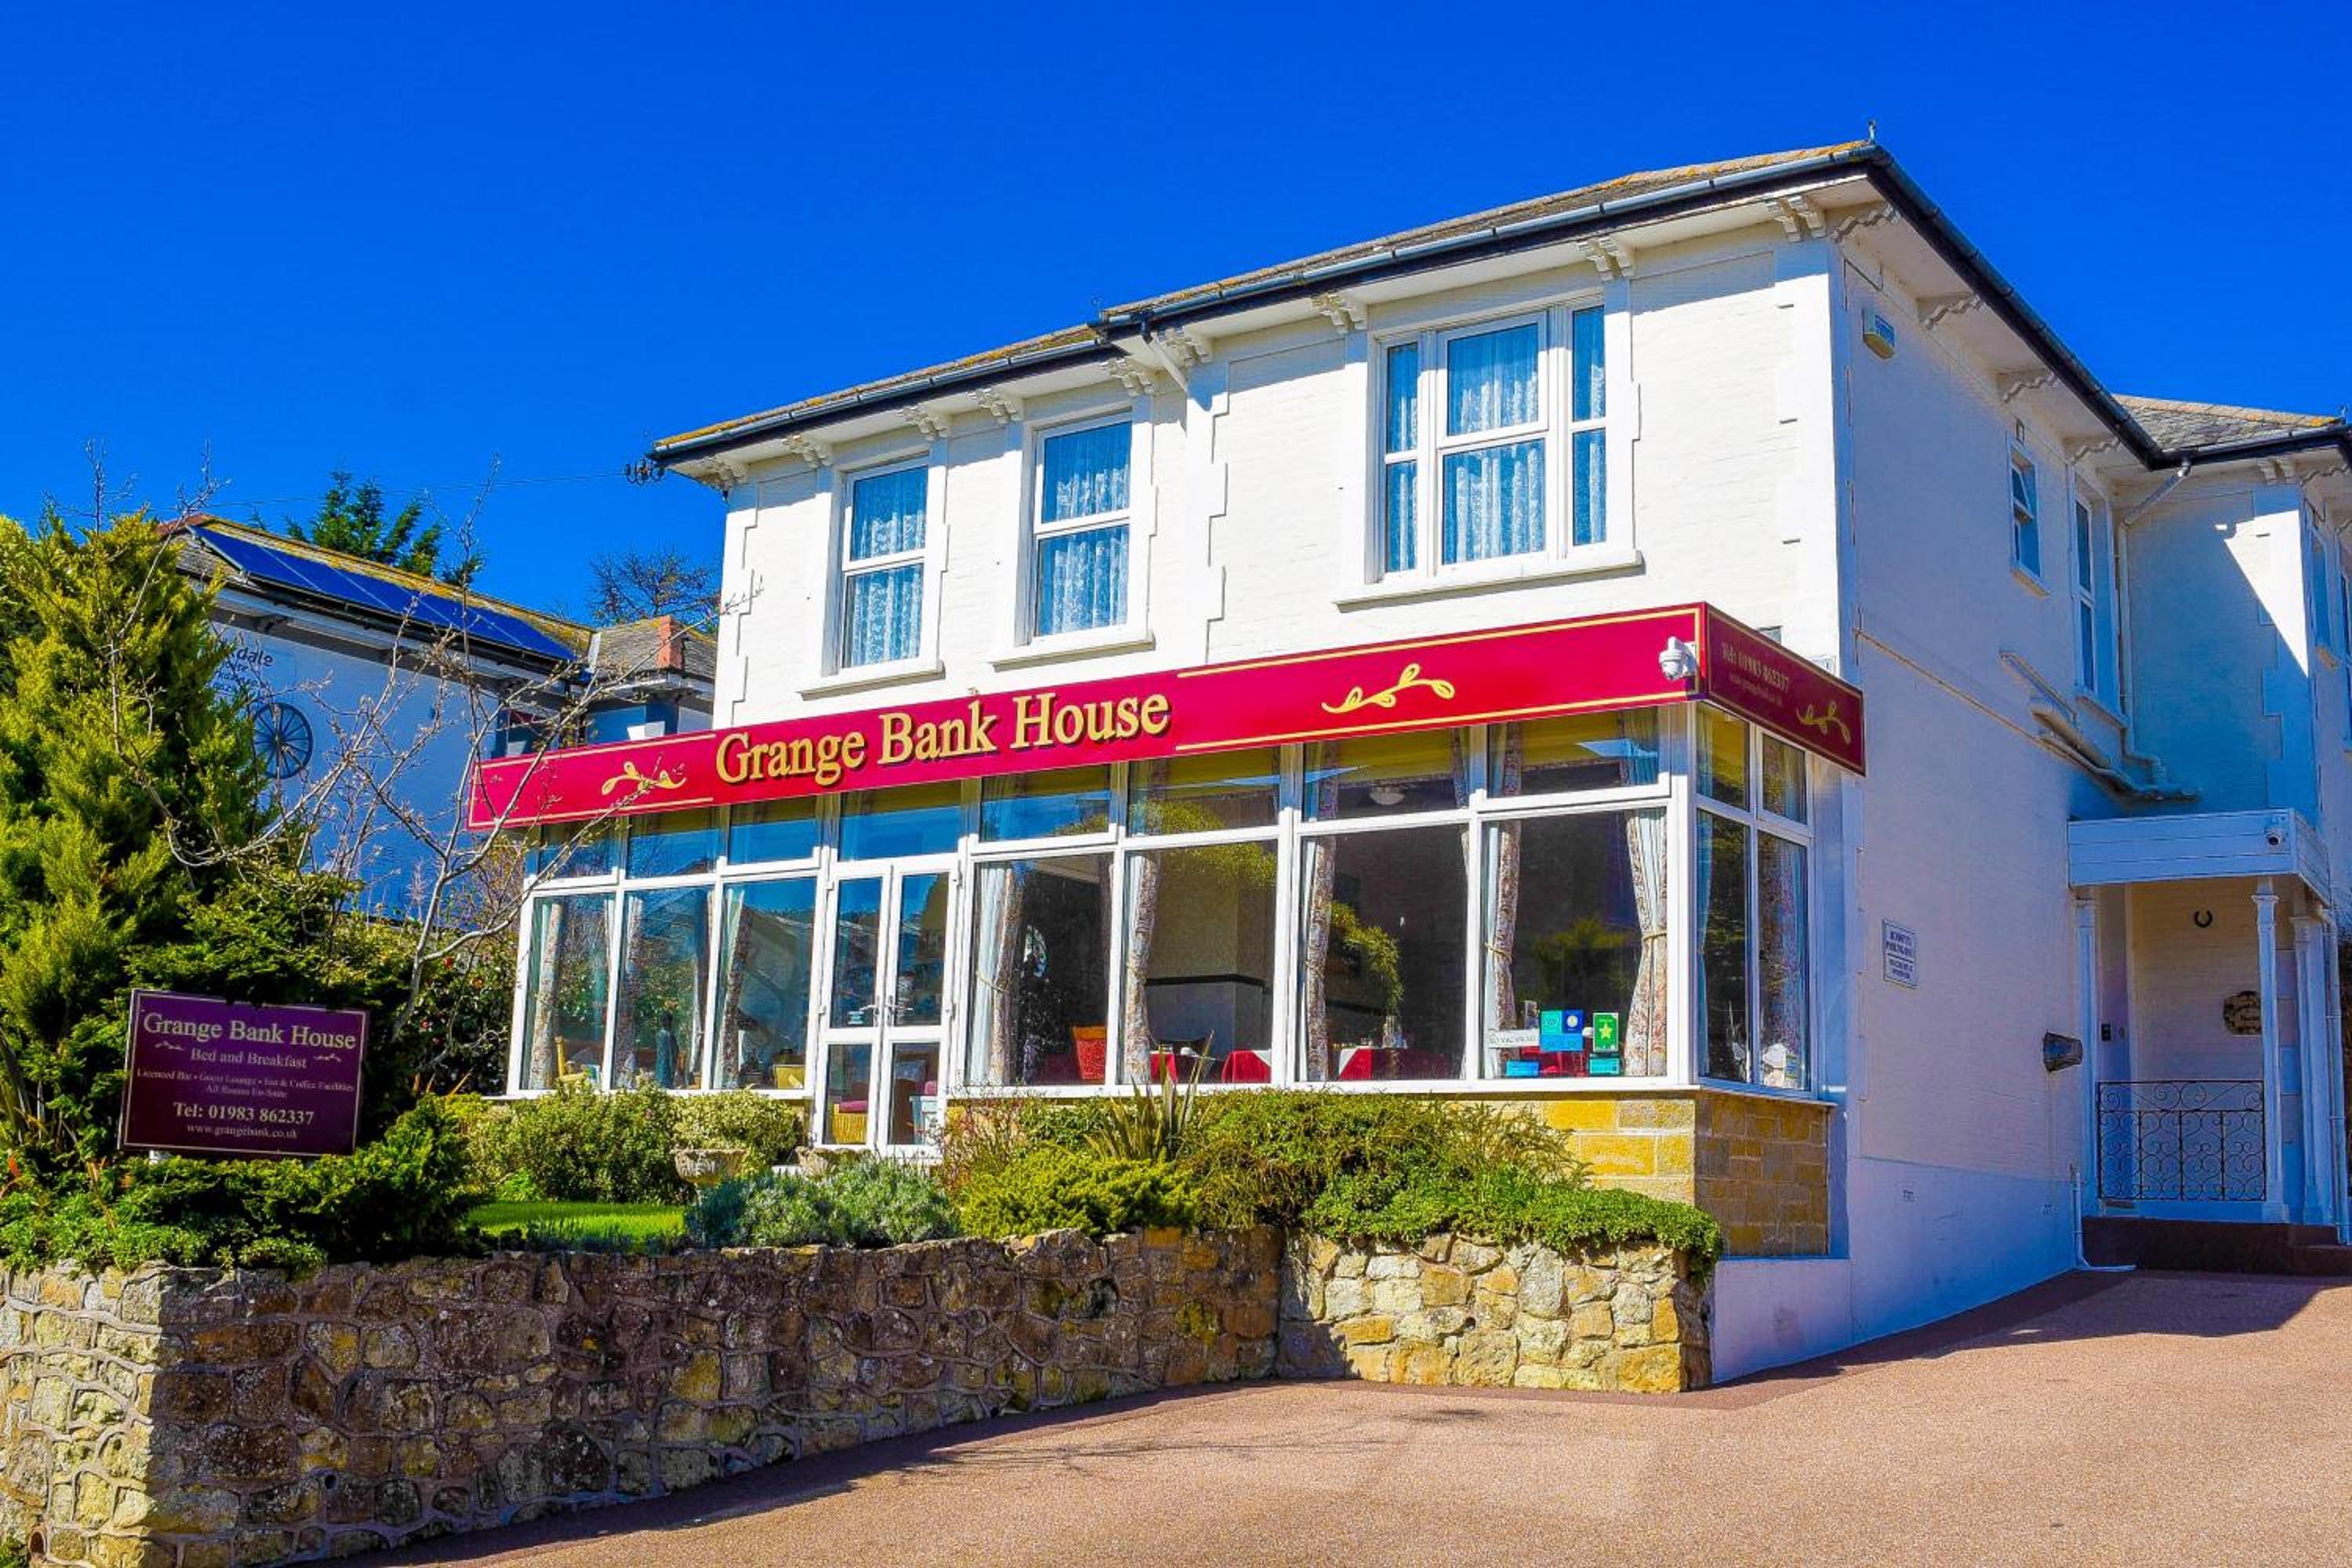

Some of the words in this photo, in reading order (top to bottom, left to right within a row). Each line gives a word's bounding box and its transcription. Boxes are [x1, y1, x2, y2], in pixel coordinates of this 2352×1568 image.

[716, 732, 865, 786] Grange
[878, 701, 997, 765] Bank
[1011, 693, 1171, 750] House
[143, 1013, 223, 1044] Grange
[229, 1020, 284, 1044] Bank
[290, 1025, 356, 1049] House
[191, 1047, 216, 1063] Bed
[220, 1051, 244, 1065] and
[248, 1052, 307, 1069] Breakfast
[172, 1101, 204, 1118] Tel:
[208, 1104, 255, 1122] 01983
[260, 1107, 314, 1126] 862337
[187, 1123, 299, 1139] www.grangebank.co.uk
